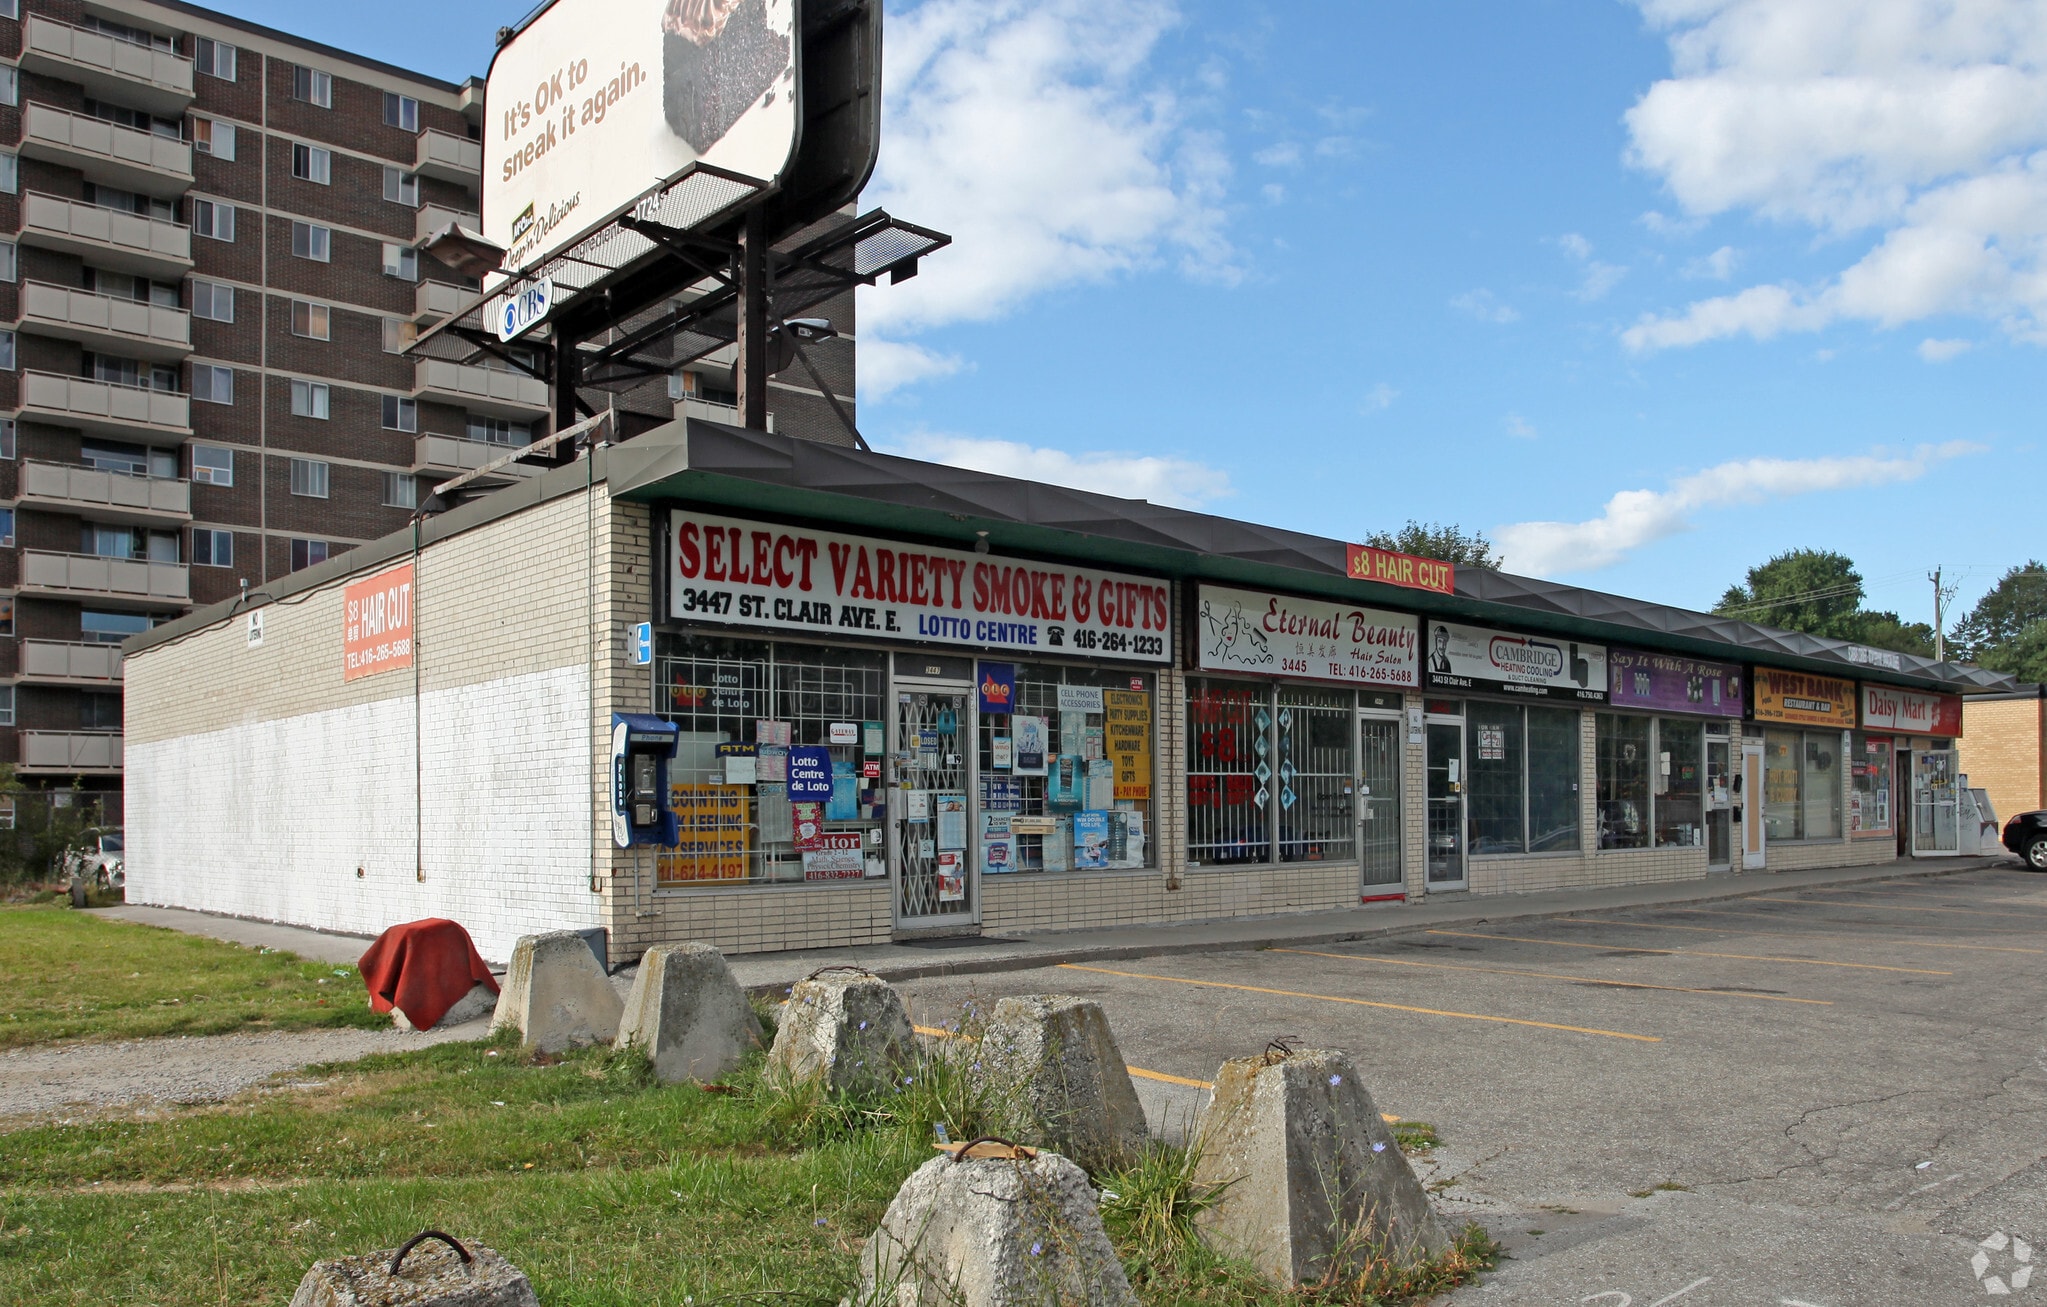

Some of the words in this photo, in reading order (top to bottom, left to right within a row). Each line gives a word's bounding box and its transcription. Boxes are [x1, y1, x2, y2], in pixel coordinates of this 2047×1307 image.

[504, 102, 530, 141] It's
[535, 68, 563, 116] OK
[567, 58, 588, 88] to
[502, 123, 556, 183] sneak
[562, 105, 576, 140] it
[581, 62, 646, 126] again.
[635, 192, 660, 222] 1724
[534, 191, 580, 245] Delicious
[518, 283, 545, 328] CBS
[679, 521, 817, 593] SELECT
[828, 541, 968, 610] VARIETY
[972, 561, 1067, 621] SMOKE
[1072, 573, 1092, 624] &
[1098, 578, 1168, 632] GIFTS
[1353, 551, 1370, 577] $8
[1375, 554, 1414, 584] HAIR
[1418, 562, 1448, 589] CUT
[347, 600, 358, 623] $8
[361, 591, 386, 639] HAIR
[388, 583, 410, 631] CUT
[682, 587, 733, 613] 3447
[739, 595, 769, 620] ST.
[773, 598, 833, 627] CLAIR
[838, 608, 875, 631] AVE.
[879, 611, 901, 632] E.
[918, 613, 972, 641] LOTTO
[976, 620, 1037, 645] CENTRE
[1073, 628, 1164, 656] 416-264-1233
[1262, 597, 1341, 641] Eternal
[1346, 611, 1416, 661] Beauty
[346, 639, 411, 670] TEL:416-265-5688
[1350, 648, 1373, 662] Hair
[1375, 649, 1402, 665] Salon
[1495, 645, 1558, 668] CAMBRIDGE
[1281, 658, 1307, 673] 3445
[1328, 662, 1347, 677] TEL:
[1348, 666, 1412, 682] 416-265-5688
[1500, 663, 1526, 674] HEATING
[1526, 665, 1553, 678] COOLING
[1610, 652, 1634, 669] Say
[1636, 655, 1649, 667] It
[1652, 658, 1682, 673] With
[1683, 663, 1694, 674] A
[1697, 665, 1722, 678] Rose
[712, 673, 738, 684] Lotto
[712, 687, 745, 697] Centre
[982, 683, 1010, 696] OLG
[1060, 689, 1074, 698] CELL
[1076, 690, 1098, 699] PHONE
[1767, 671, 1805, 696] WEST
[1806, 677, 1843, 703] BANK
[712, 698, 724, 708] de
[727, 698, 750, 709] Loto
[1060, 700, 1101, 709] ACCESSORIES
[1111, 692, 1143, 705] ELECTRONICS
[1783, 698, 1816, 711] RESTAURANT
[1821, 703, 1831, 713] BAR
[1109, 708, 1122, 721] PARTY
[1124, 709, 1148, 722] SUPPLIES
[1869, 690, 1898, 728] Daisy
[1902, 695, 1926, 721] Mart
[1110, 724, 1144, 737] KITCHENWARE
[641, 734, 663, 742] Phone
[920, 737, 937, 746] LOSED
[719, 745, 755, 753] ATM
[1114, 740, 1140, 752] HARDWARE
[791, 756, 818, 767] Lotto
[954, 755, 962, 764] 19
[1121, 755, 1134, 768] TOYS
[864, 763, 880, 771] ATM
[791, 769, 824, 780] Centre
[1121, 771, 1135, 782] GIFTS
[791, 781, 804, 792] de
[807, 781, 829, 792] Loto
[1123, 787, 1132, 797] PAY
[1133, 787, 1147, 797] PHONE
[671, 790, 738, 808] COUNTING
[689, 814, 743, 832] KEEPING
[988, 816, 994, 826] 2
[821, 835, 859, 849] utor
[680, 840, 744, 860] SERVICES
[658, 863, 743, 881] 16-624-4197
